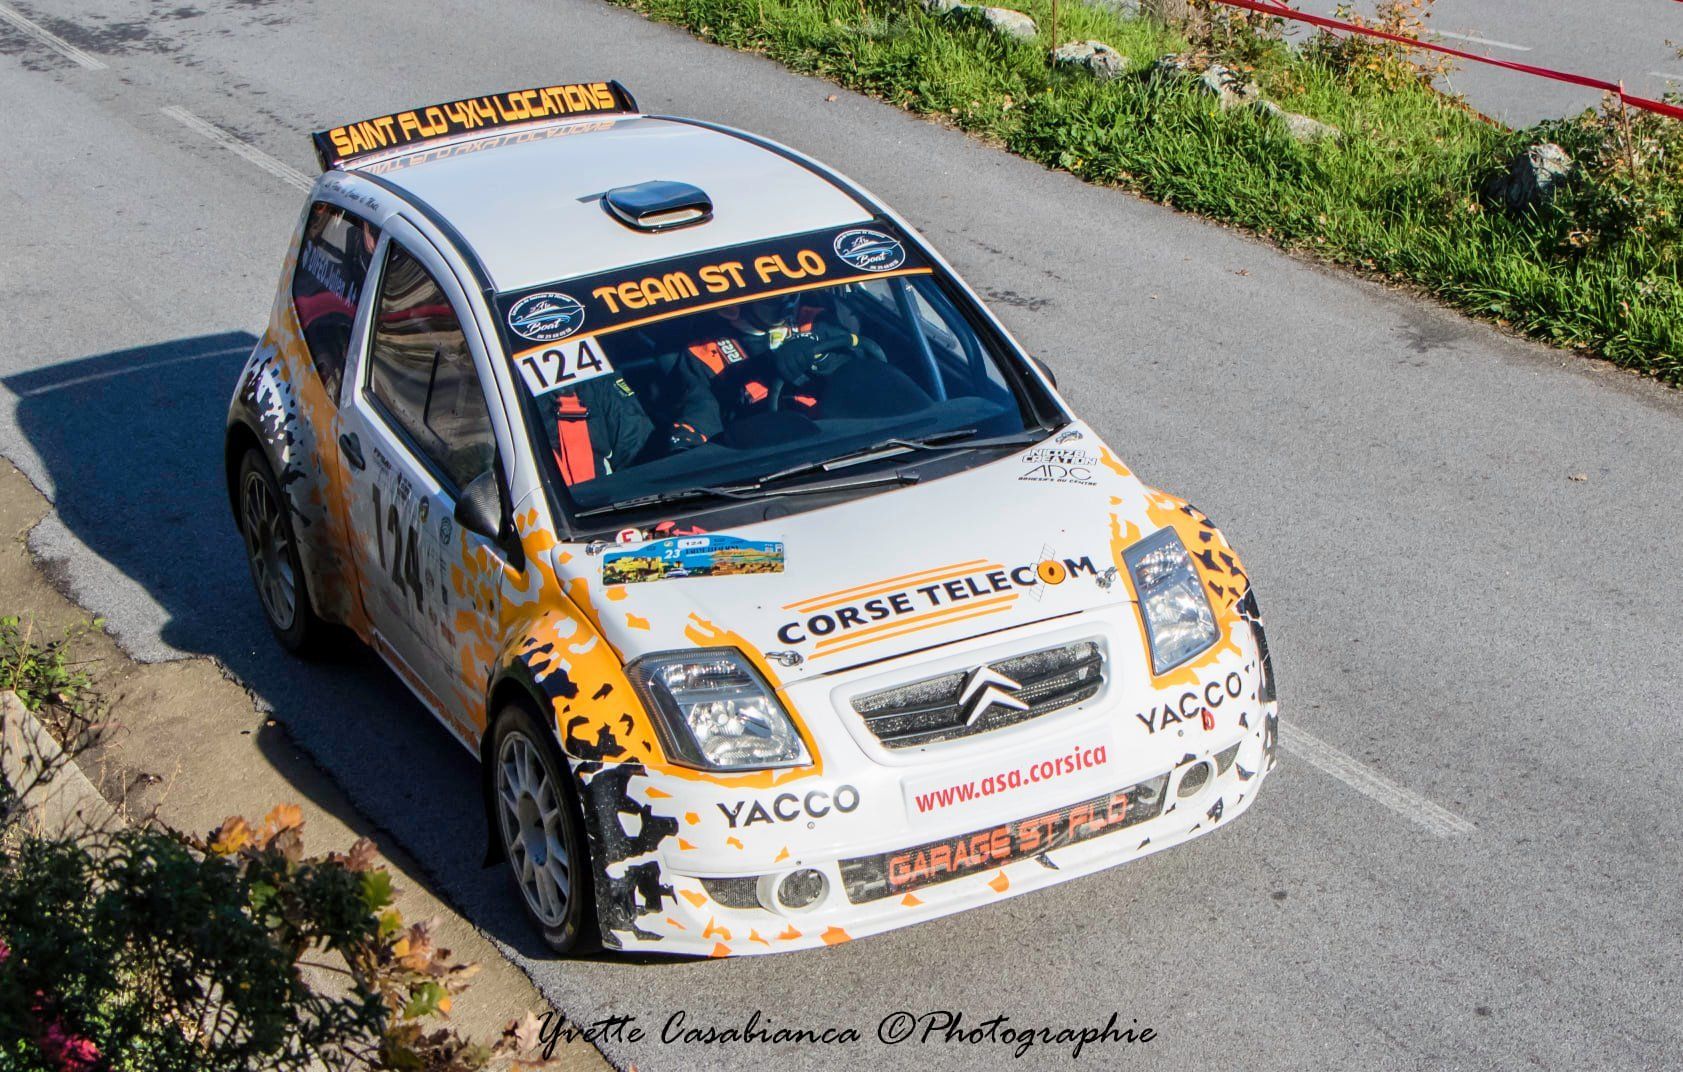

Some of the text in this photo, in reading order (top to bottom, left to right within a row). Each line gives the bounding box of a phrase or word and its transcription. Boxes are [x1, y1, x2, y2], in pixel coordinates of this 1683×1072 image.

[330, 82, 616, 156] SAINT FLO 4X4 LOCATIONS
[592, 271, 700, 313] TEAM
[699, 261, 744, 293] ST
[754, 249, 827, 284] FLO
[522, 340, 603, 388] 124
[1023, 464, 1092, 480] ADC
[372, 482, 425, 615] 124
[777, 556, 1099, 645] CORSE TELECOM
[1136, 676, 1243, 736] YACCO
[716, 783, 861, 829] YACCO
[914, 743, 1108, 815] www.asa.corsica
[888, 794, 1129, 886] GARAGE ST FLO
